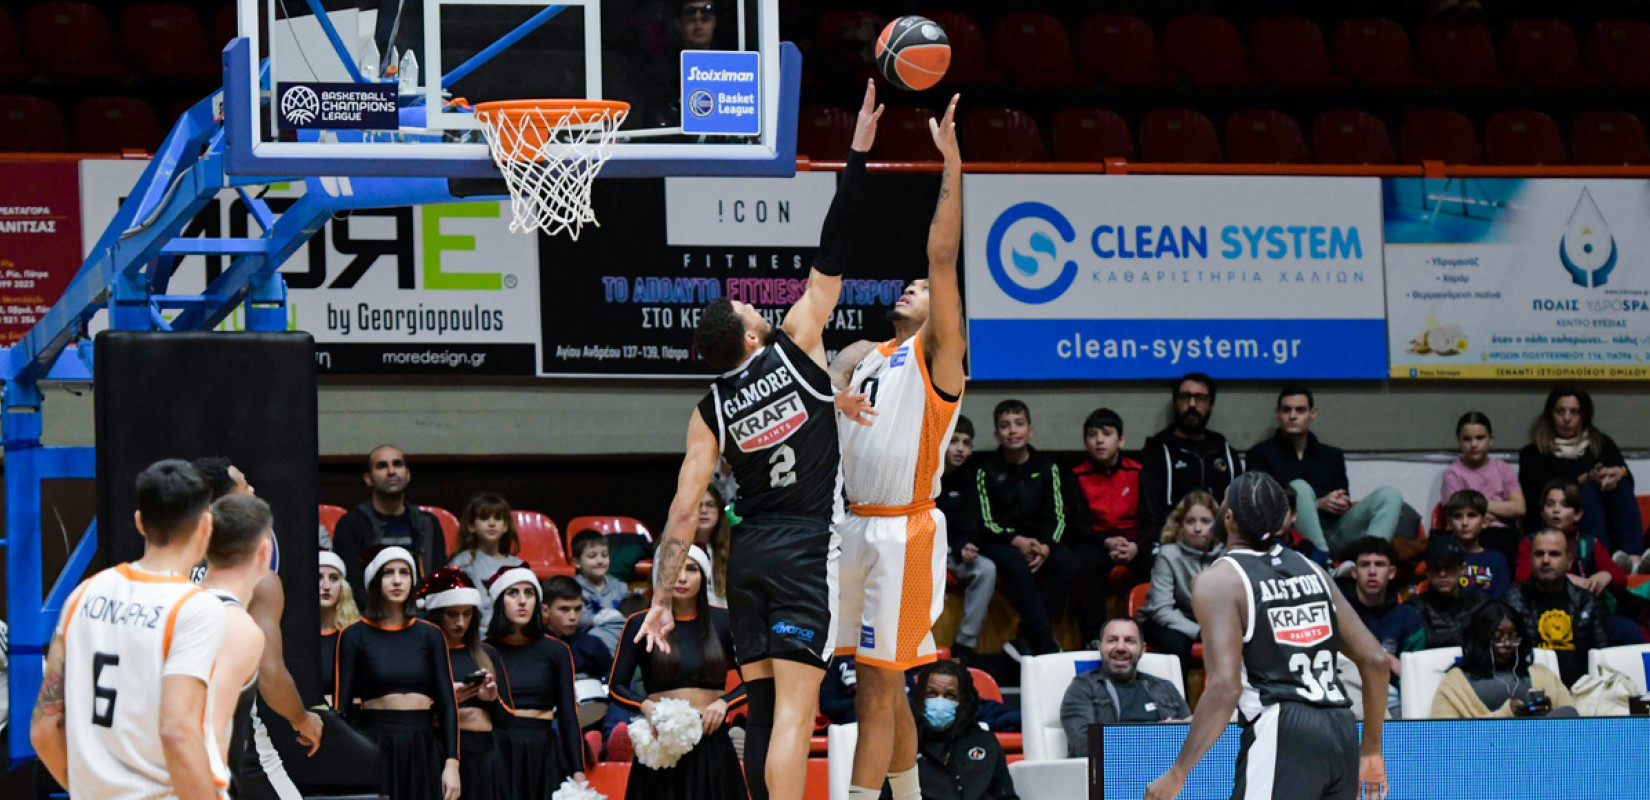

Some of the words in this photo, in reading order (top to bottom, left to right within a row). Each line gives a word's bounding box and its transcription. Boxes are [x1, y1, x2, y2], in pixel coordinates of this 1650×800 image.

[688, 66, 754, 82] Stoiximan
[322, 91, 388, 101] BASKETBALL
[718, 92, 754, 104] Basket
[322, 101, 396, 113] CHAMPIONS
[322, 111, 362, 121] LEAGUE
[718, 104, 755, 117] League
[1091, 225, 1208, 259] CLEAN
[1221, 225, 1363, 260] SYSTEM
[682, 253, 803, 269] FITNES
[1092, 270, 1263, 284] ΚΑΘΑΡΙΣΤΗΡΙΑ
[1279, 270, 1365, 284] ΧΑΛΙΩΝ
[602, 276, 629, 303] ΤΟ
[632, 276, 722, 303] ΑΠΟΛΥΤΟ
[1533, 299, 1580, 311] ΠΟΛΙΣ
[327, 303, 351, 335] by
[358, 302, 504, 335] Georgiopoulos
[641, 308, 674, 328] ΣΤΟ
[382, 349, 487, 368] moredesign.gr
[1057, 333, 1302, 364] clean-system.gr
[732, 394, 799, 441] KRAFT
[757, 422, 792, 445] PAINTS
[768, 443, 798, 489] 2
[1259, 573, 1324, 602] ALSTON
[1271, 605, 1328, 629] KRAFT
[1290, 628, 1323, 640] PAINTS
[1289, 649, 1345, 702] 32
[92, 650, 119, 728] 6
